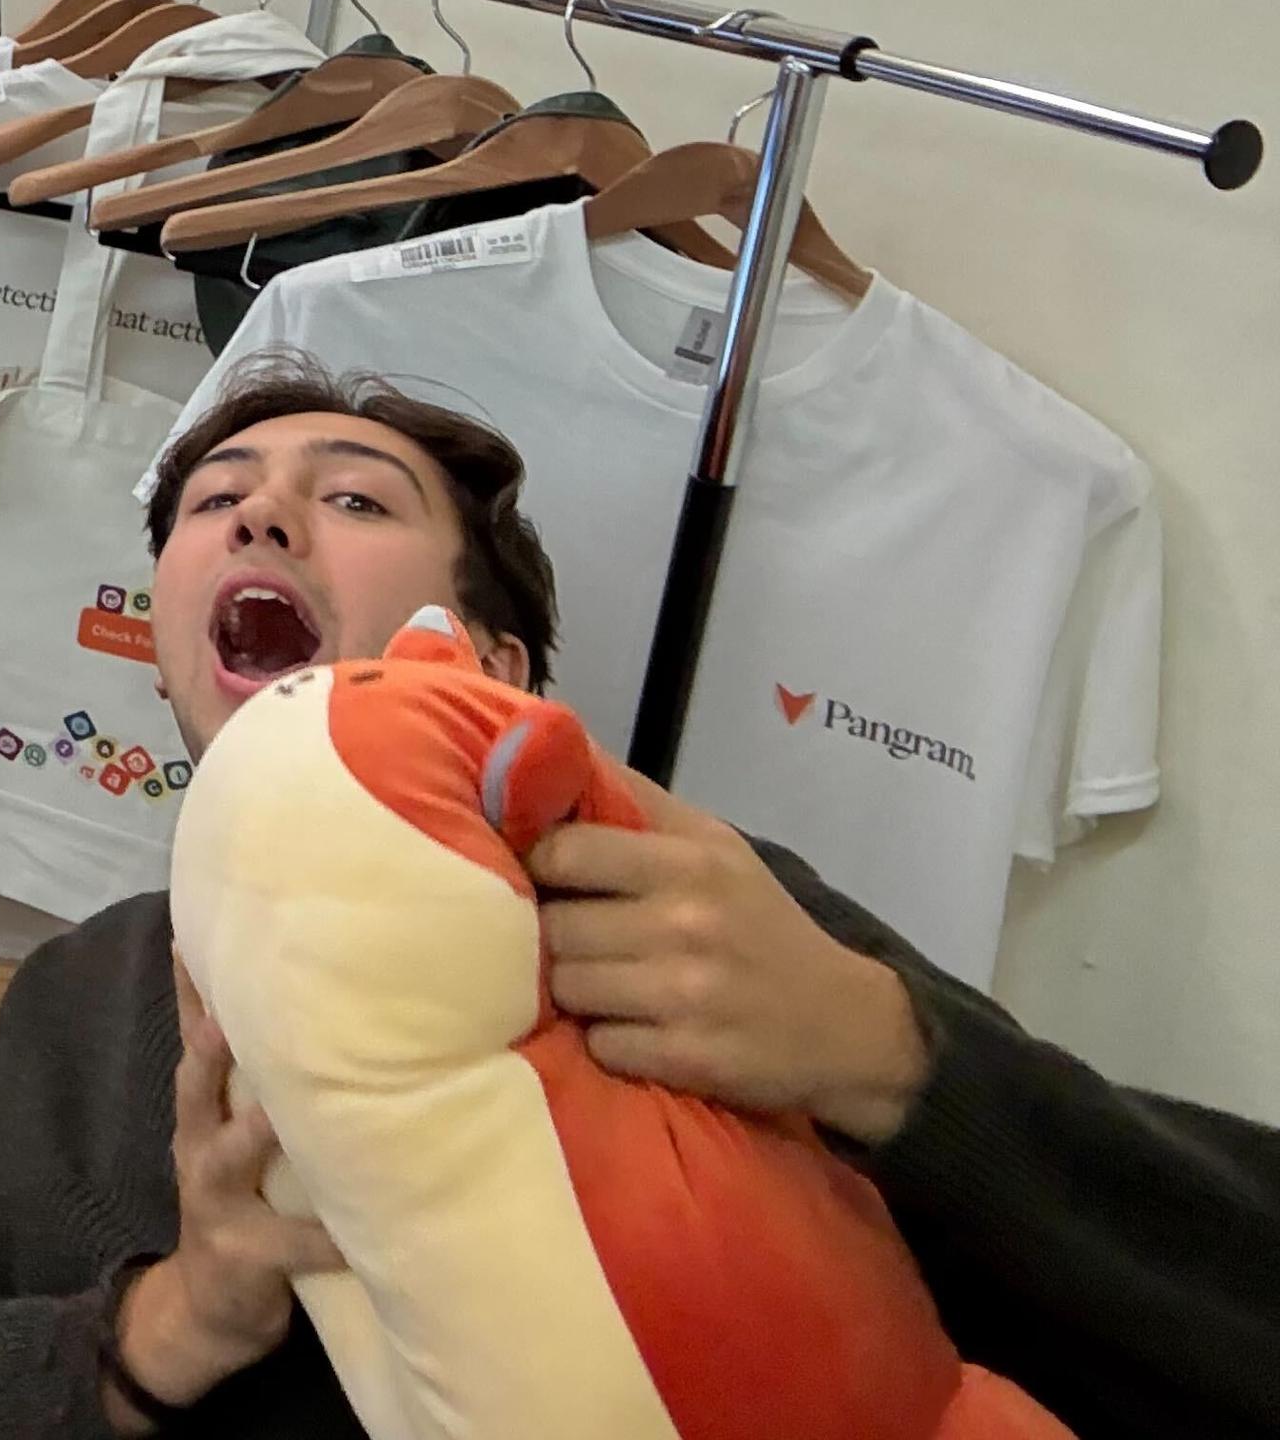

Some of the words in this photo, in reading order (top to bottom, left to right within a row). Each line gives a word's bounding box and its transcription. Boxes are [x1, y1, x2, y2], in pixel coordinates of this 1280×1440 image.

[107, 303, 148, 333] hat
[91, 623, 132, 644] Check
[824, 698, 976, 781] Pangram
